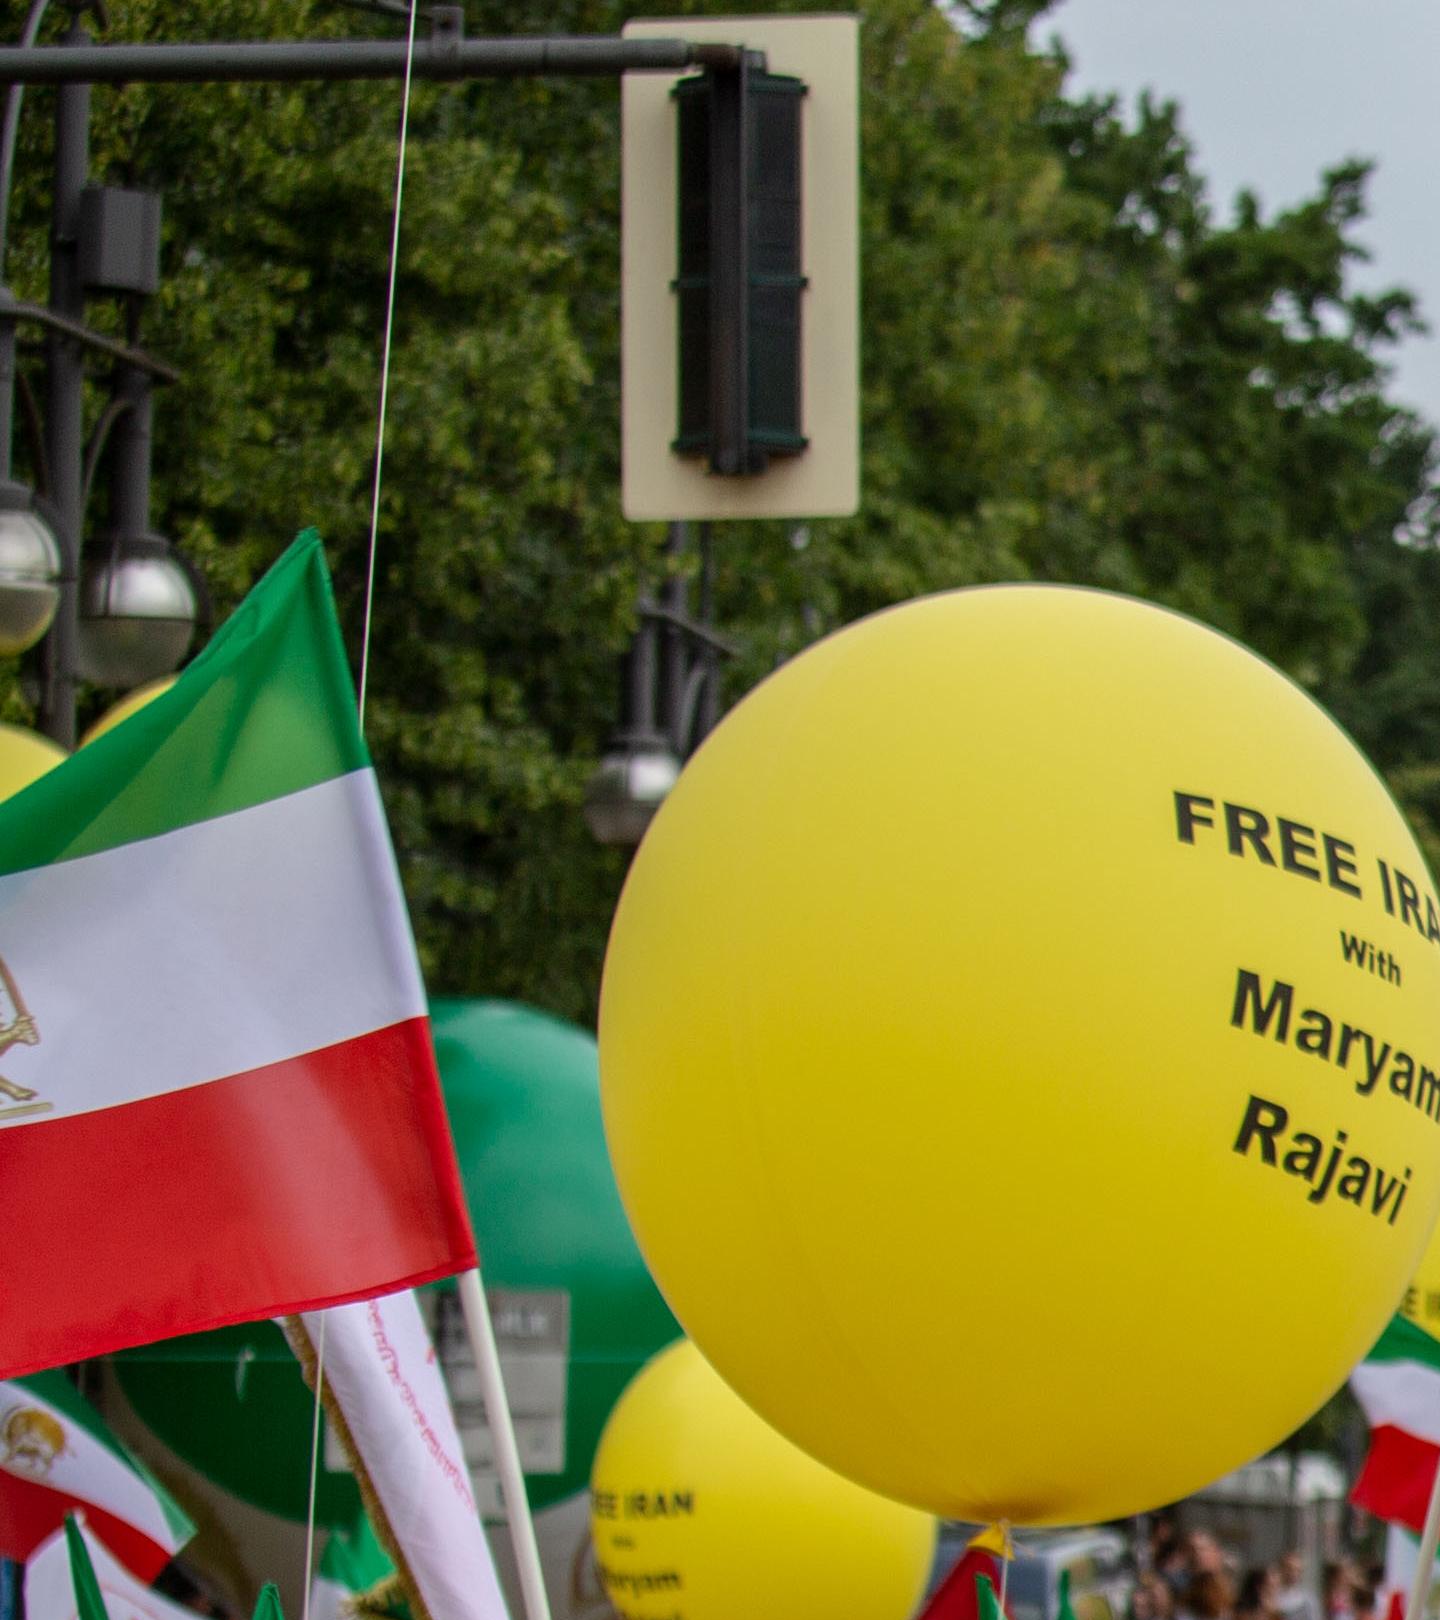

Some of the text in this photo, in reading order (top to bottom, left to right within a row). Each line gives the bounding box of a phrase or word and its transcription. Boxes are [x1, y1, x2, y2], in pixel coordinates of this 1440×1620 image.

[1172, 789, 1362, 900] FREE
[1339, 929, 1402, 987] With
[1232, 1093, 1413, 1227] Rajavi
